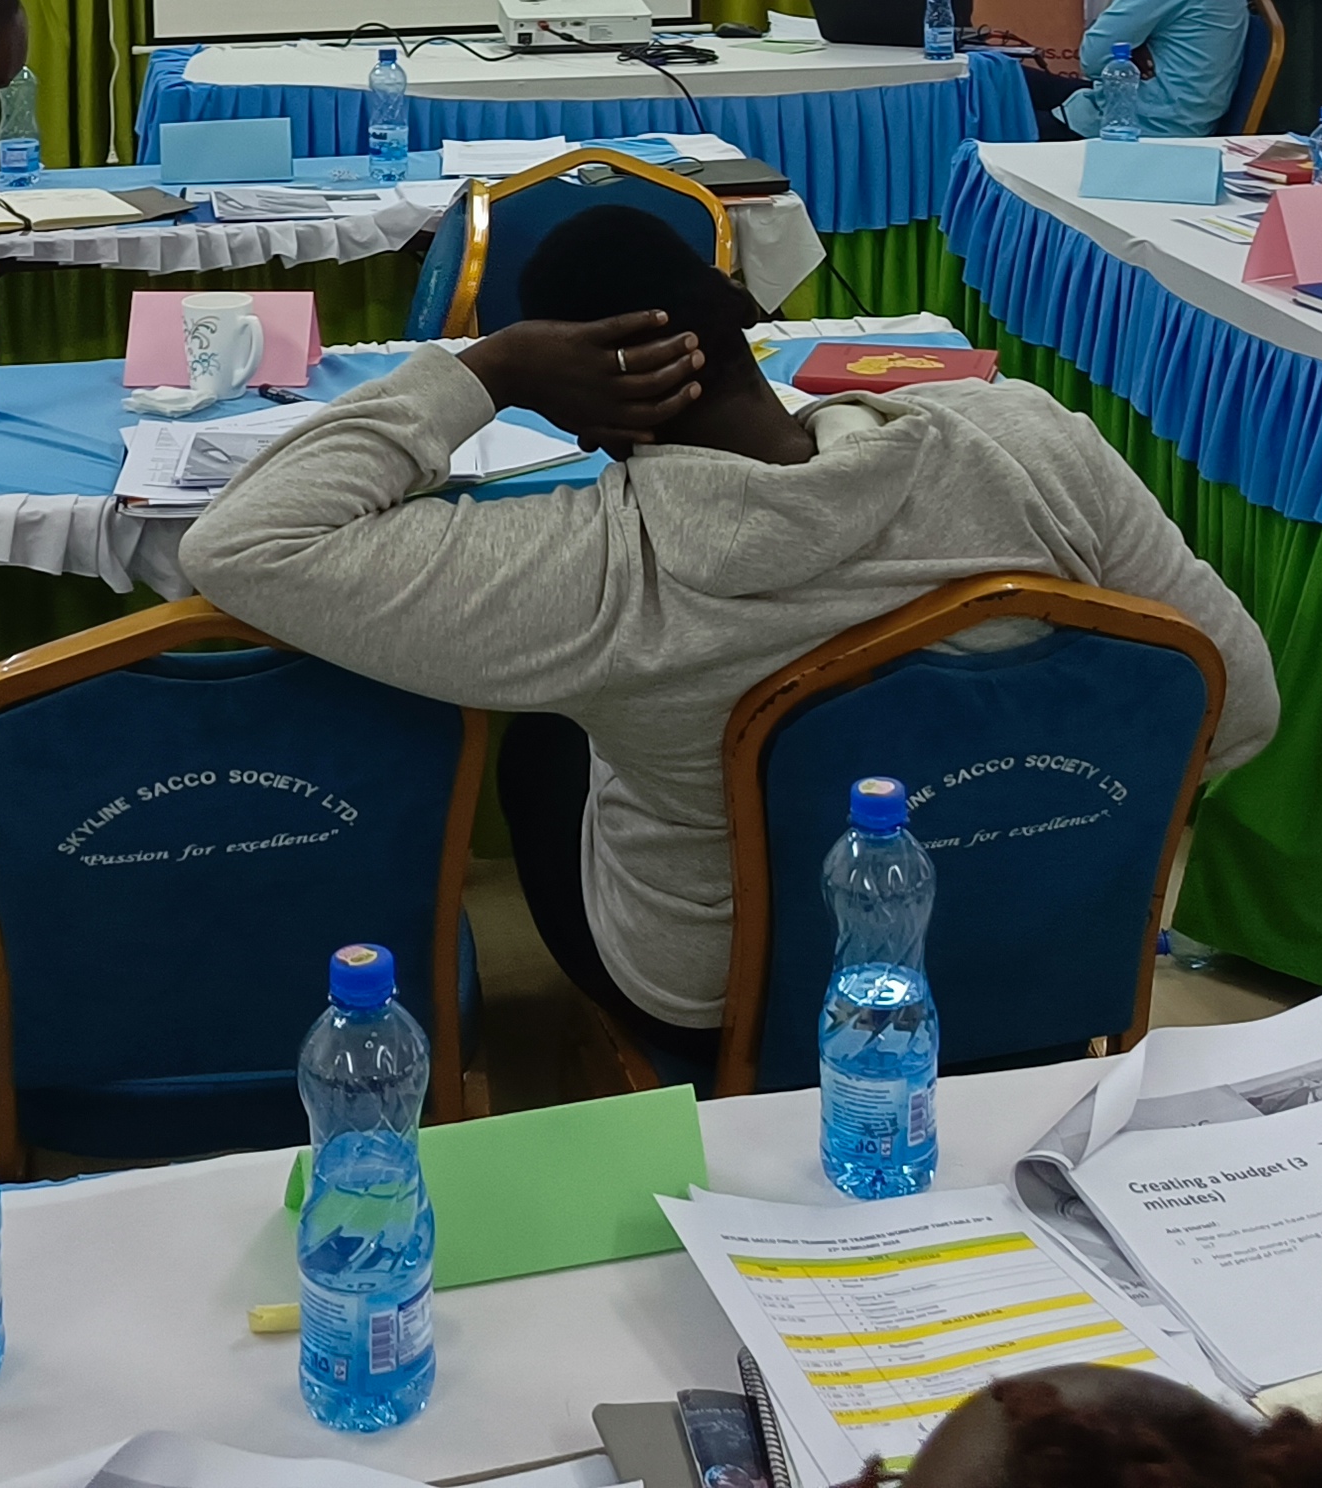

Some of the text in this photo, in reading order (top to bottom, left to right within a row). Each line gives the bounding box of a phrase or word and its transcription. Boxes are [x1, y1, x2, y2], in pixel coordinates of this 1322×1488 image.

[943, 754, 1128, 806] SACCO SOCIETY LTD.
[57, 769, 359, 856] SKYLINE SACCO SOCIETY LTD.
[964, 828, 1002, 849] for
[176, 843, 216, 862] for
[1128, 1156, 1309, 1196] Creating a budget (3
[1143, 1189, 1226, 1212] minutes)
[1217, 1228, 1241, 1240] much
[1242, 1223, 1271, 1237] money
[1285, 1214, 1305, 1225] have
[1234, 1247, 1257, 1258] much
[1259, 1240, 1288, 1253] money
[1297, 1232, 1322, 1245] going
